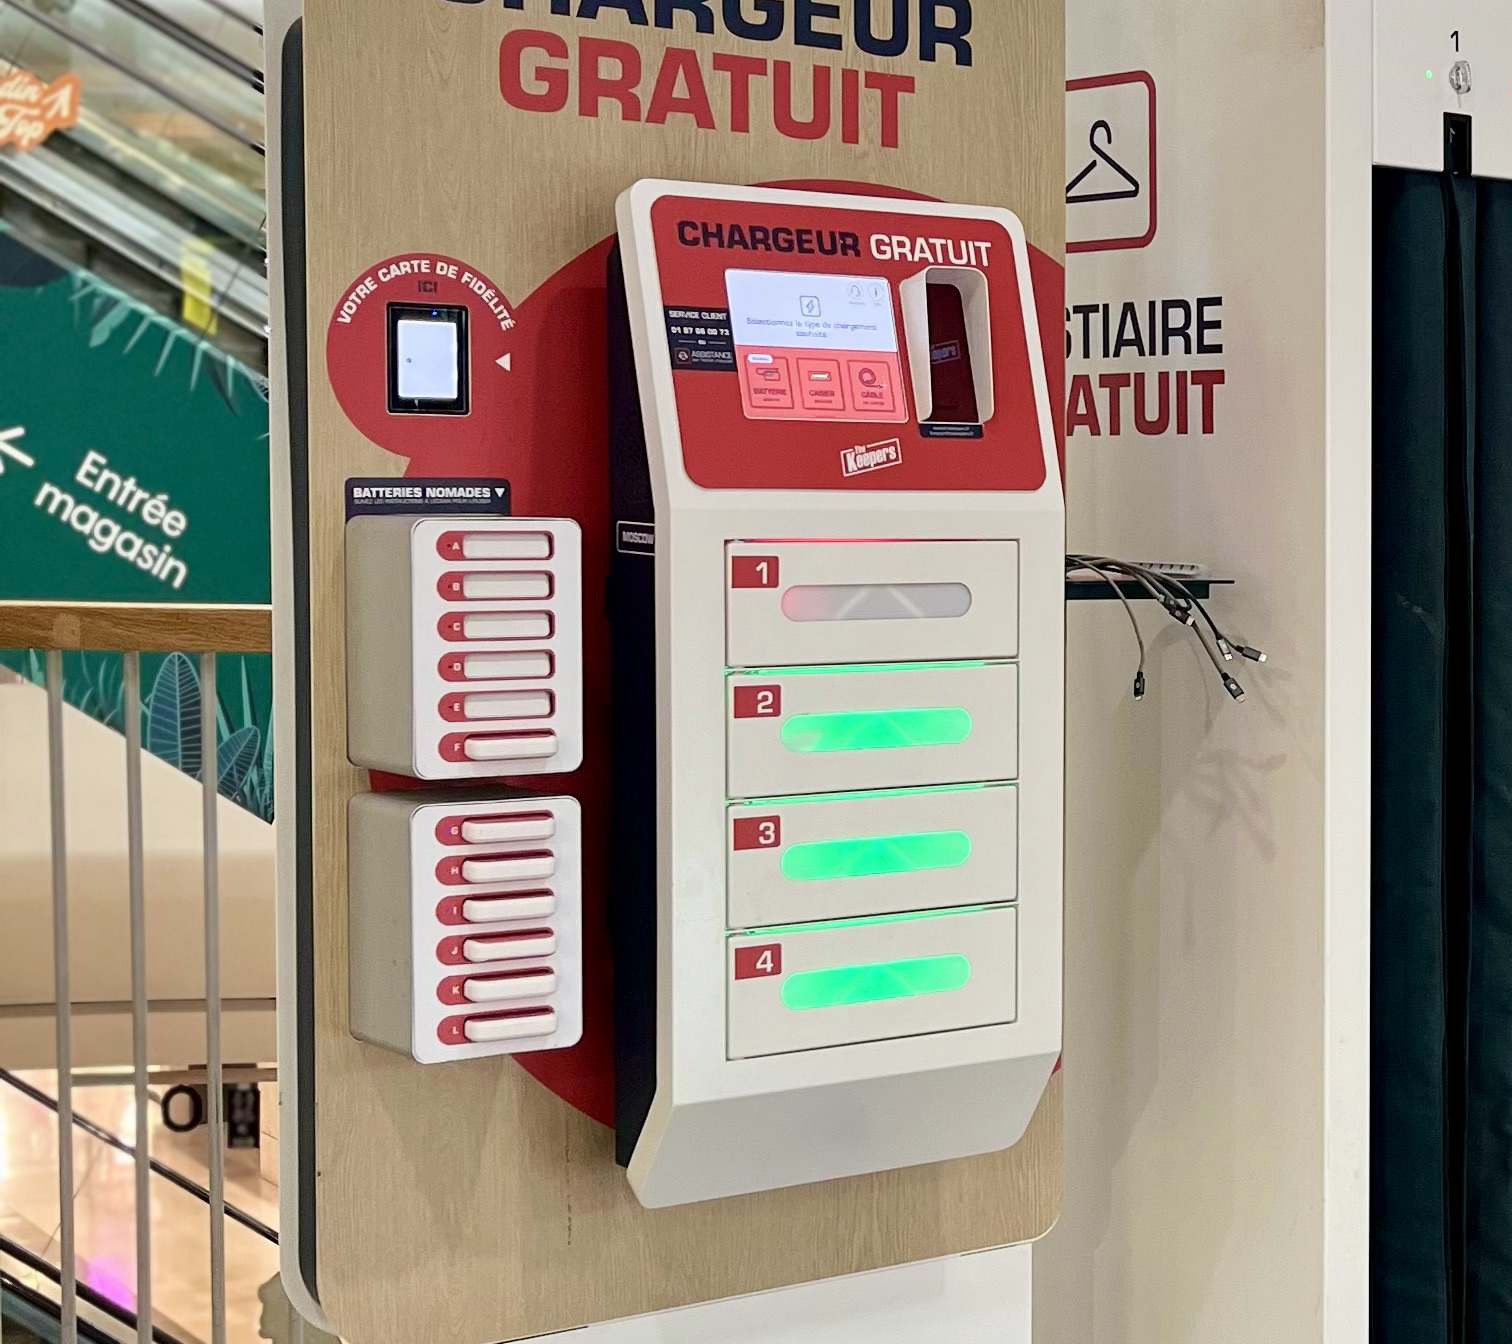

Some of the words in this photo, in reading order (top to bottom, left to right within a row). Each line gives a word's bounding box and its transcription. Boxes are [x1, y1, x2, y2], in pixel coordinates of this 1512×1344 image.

[1450, 31, 1460, 52] 1
[500, 29, 915, 148] GRATUIT
[677, 221, 861, 257] CHARGEUR
[870, 234, 992, 267] GRATUIT
[418, 280, 437, 293] ICI
[337, 276, 378, 325] VOTRE
[377, 259, 431, 283] CARTE
[435, 261, 459, 280] DE
[461, 271, 516, 331] FIDÉLITÉ
[669, 310, 699, 319] SERVICE
[701, 311, 727, 320] CLIENT
[671, 326, 681, 334] 01
[846, 445, 897, 473] Keepers
[75, 449, 187, 537] Entrée
[353, 487, 422, 498] BATTERIES
[425, 487, 491, 498] NOMADES
[34, 482, 188, 590] magasin
[452, 542, 460, 550] A
[755, 561, 769, 584] 1
[453, 582, 460, 591] B
[453, 623, 460, 631] C
[453, 663, 461, 671] D
[454, 703, 460, 711] E
[756, 691, 774, 713] 2
[454, 743, 460, 751] F
[757, 821, 775, 843] 3
[451, 866, 458, 874] H
[756, 950, 774, 972] 4
[452, 986, 459, 994] K
[452, 1026, 458, 1034] L
